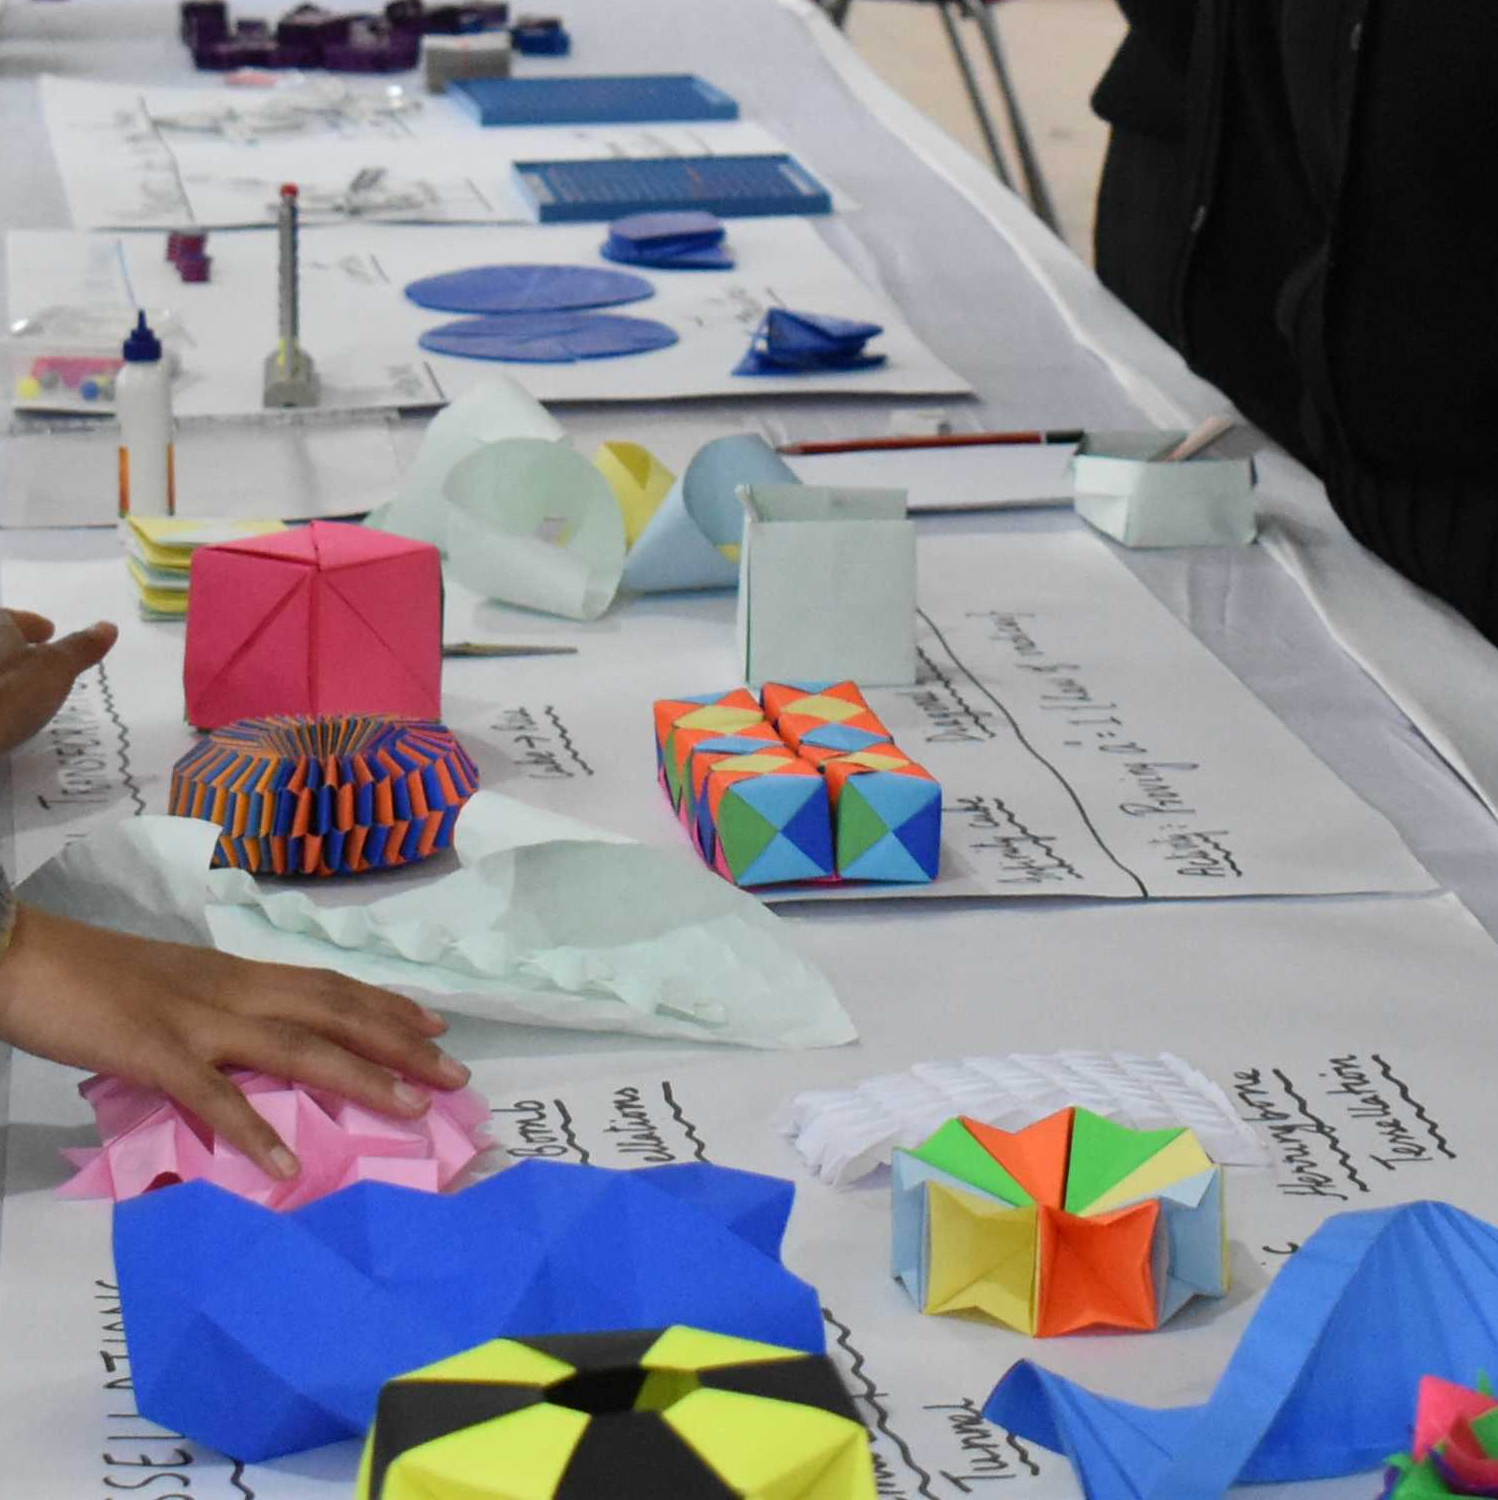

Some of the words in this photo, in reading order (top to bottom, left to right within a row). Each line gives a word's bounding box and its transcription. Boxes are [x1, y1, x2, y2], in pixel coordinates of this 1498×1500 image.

[603, 1086, 676, 1162] ellations
[1318, 1054, 1433, 1171] Tessellation
[922, 1397, 1017, 1493] Tunnel
